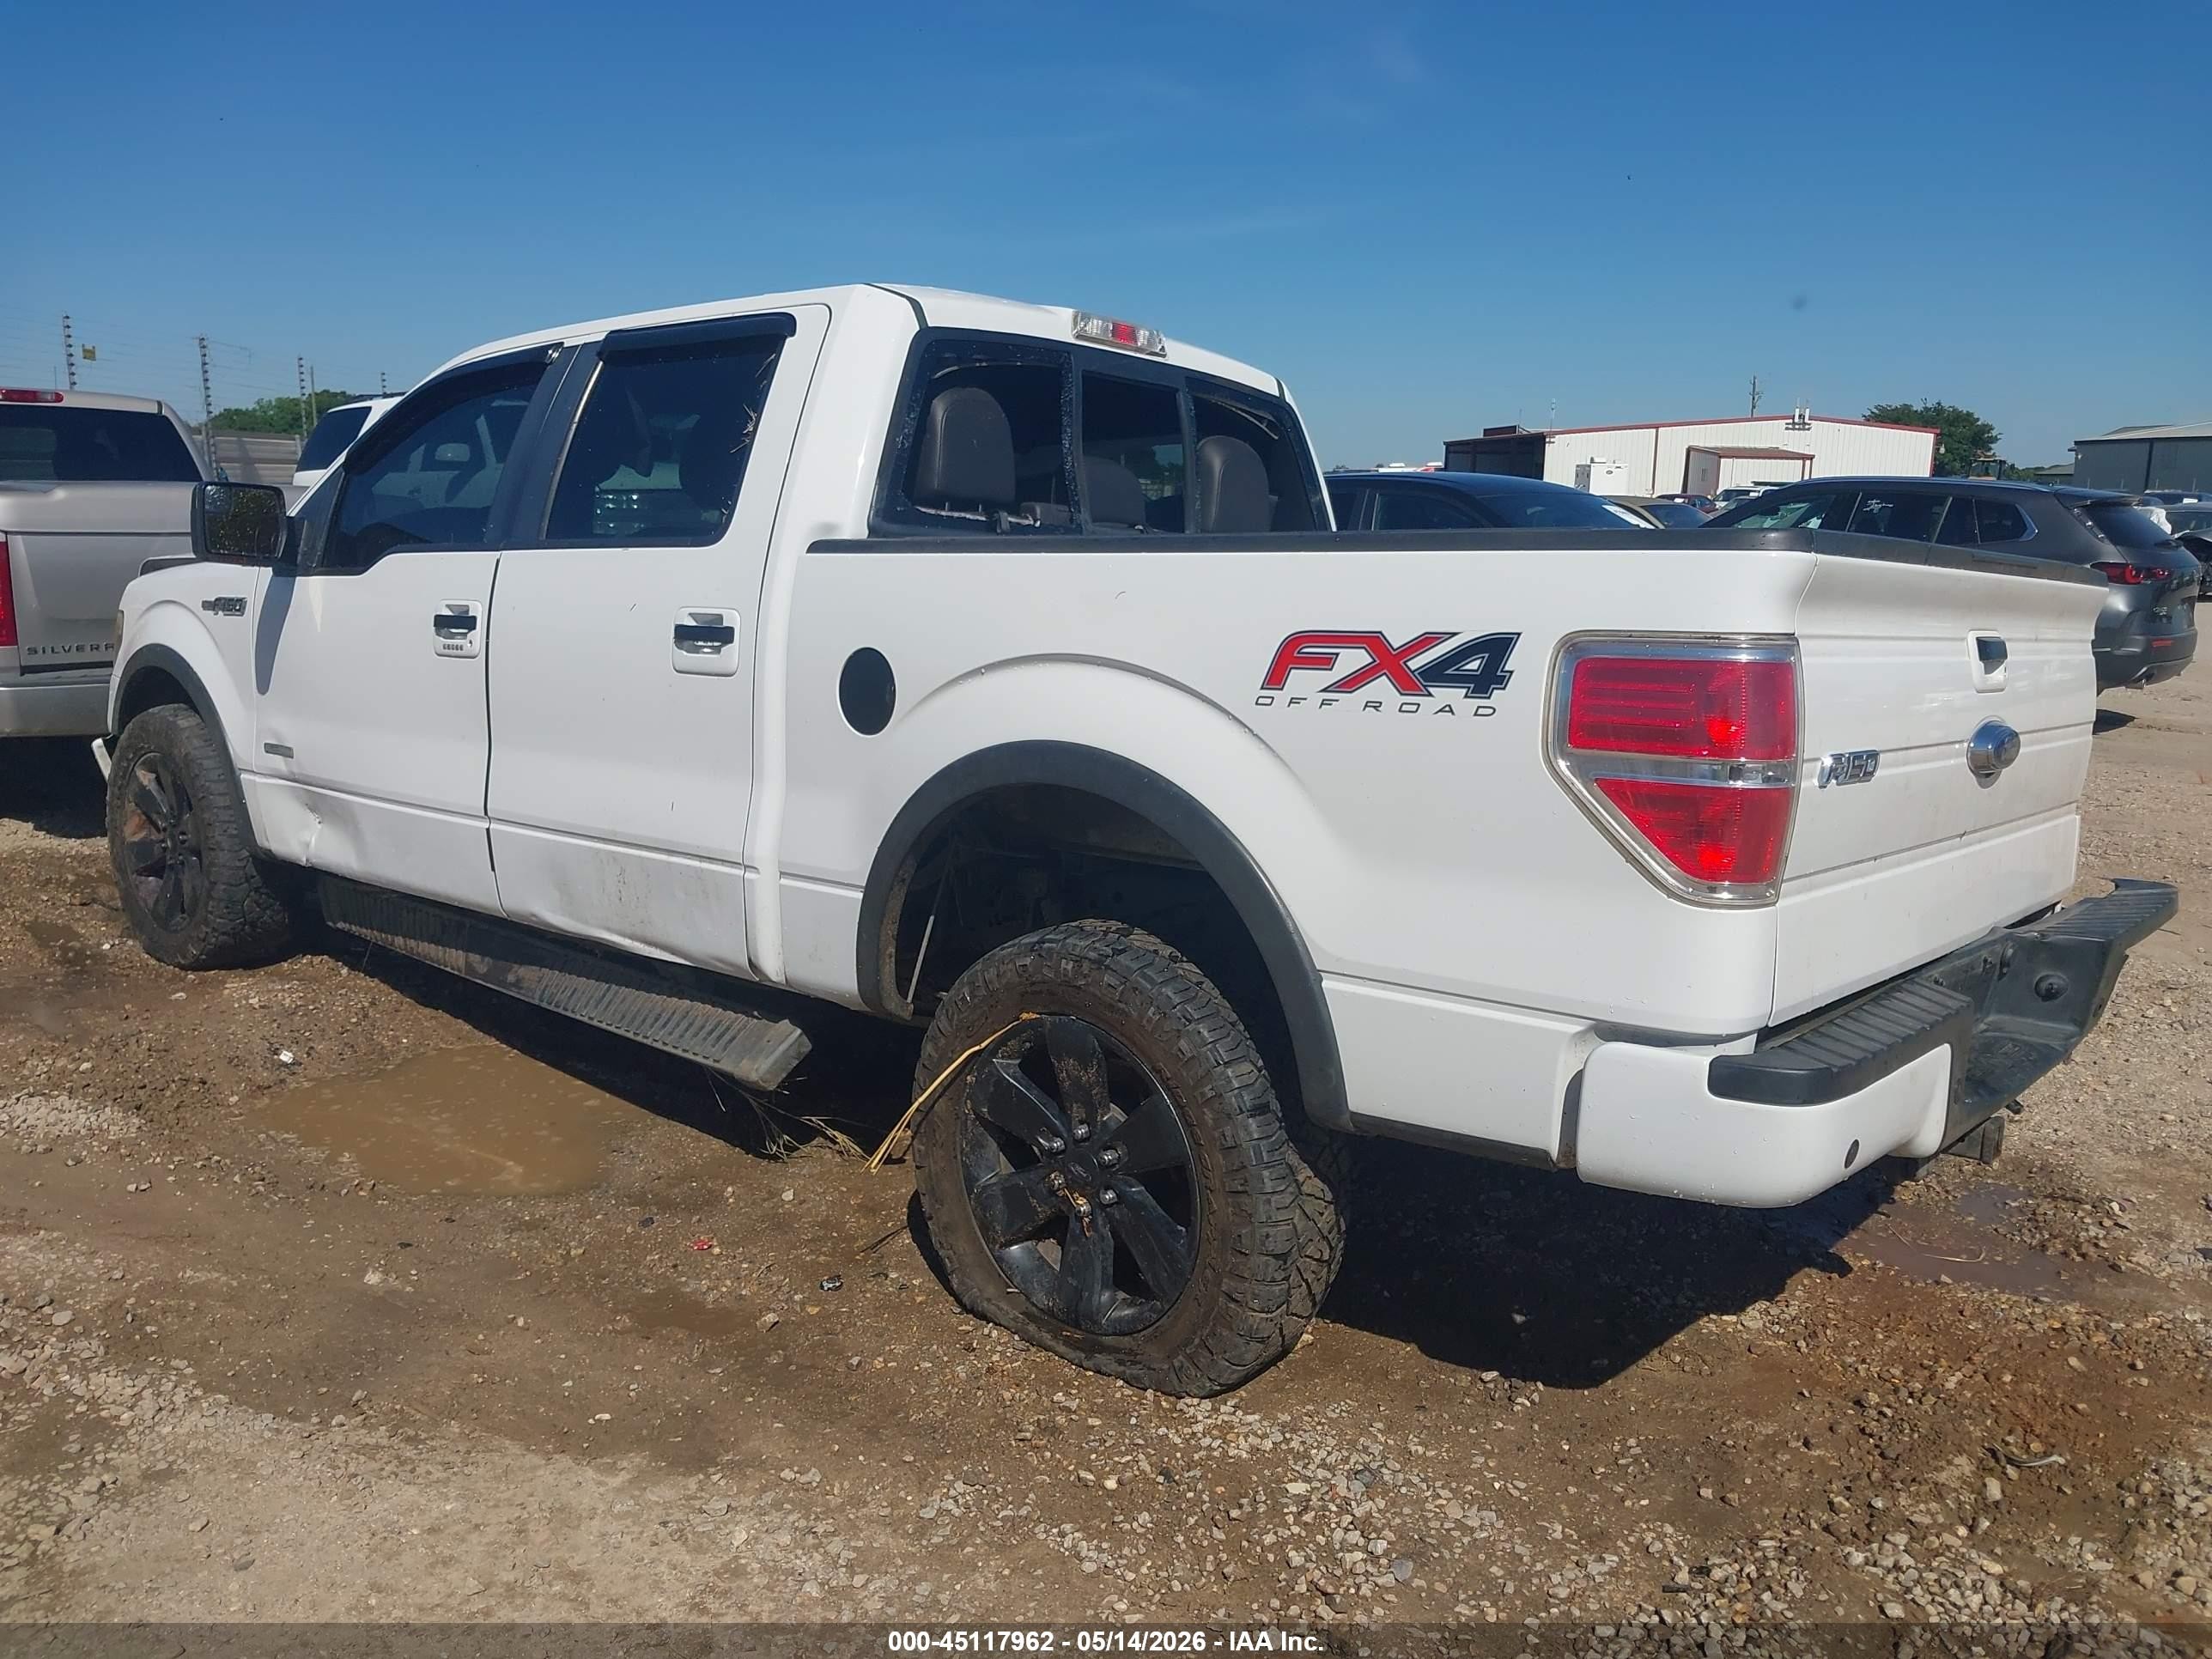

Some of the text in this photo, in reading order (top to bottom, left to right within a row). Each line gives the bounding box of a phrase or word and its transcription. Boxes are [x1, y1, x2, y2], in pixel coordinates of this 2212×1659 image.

[1260, 630, 1522, 699] FX4
[1255, 696, 1497, 717] OFF ROAD
